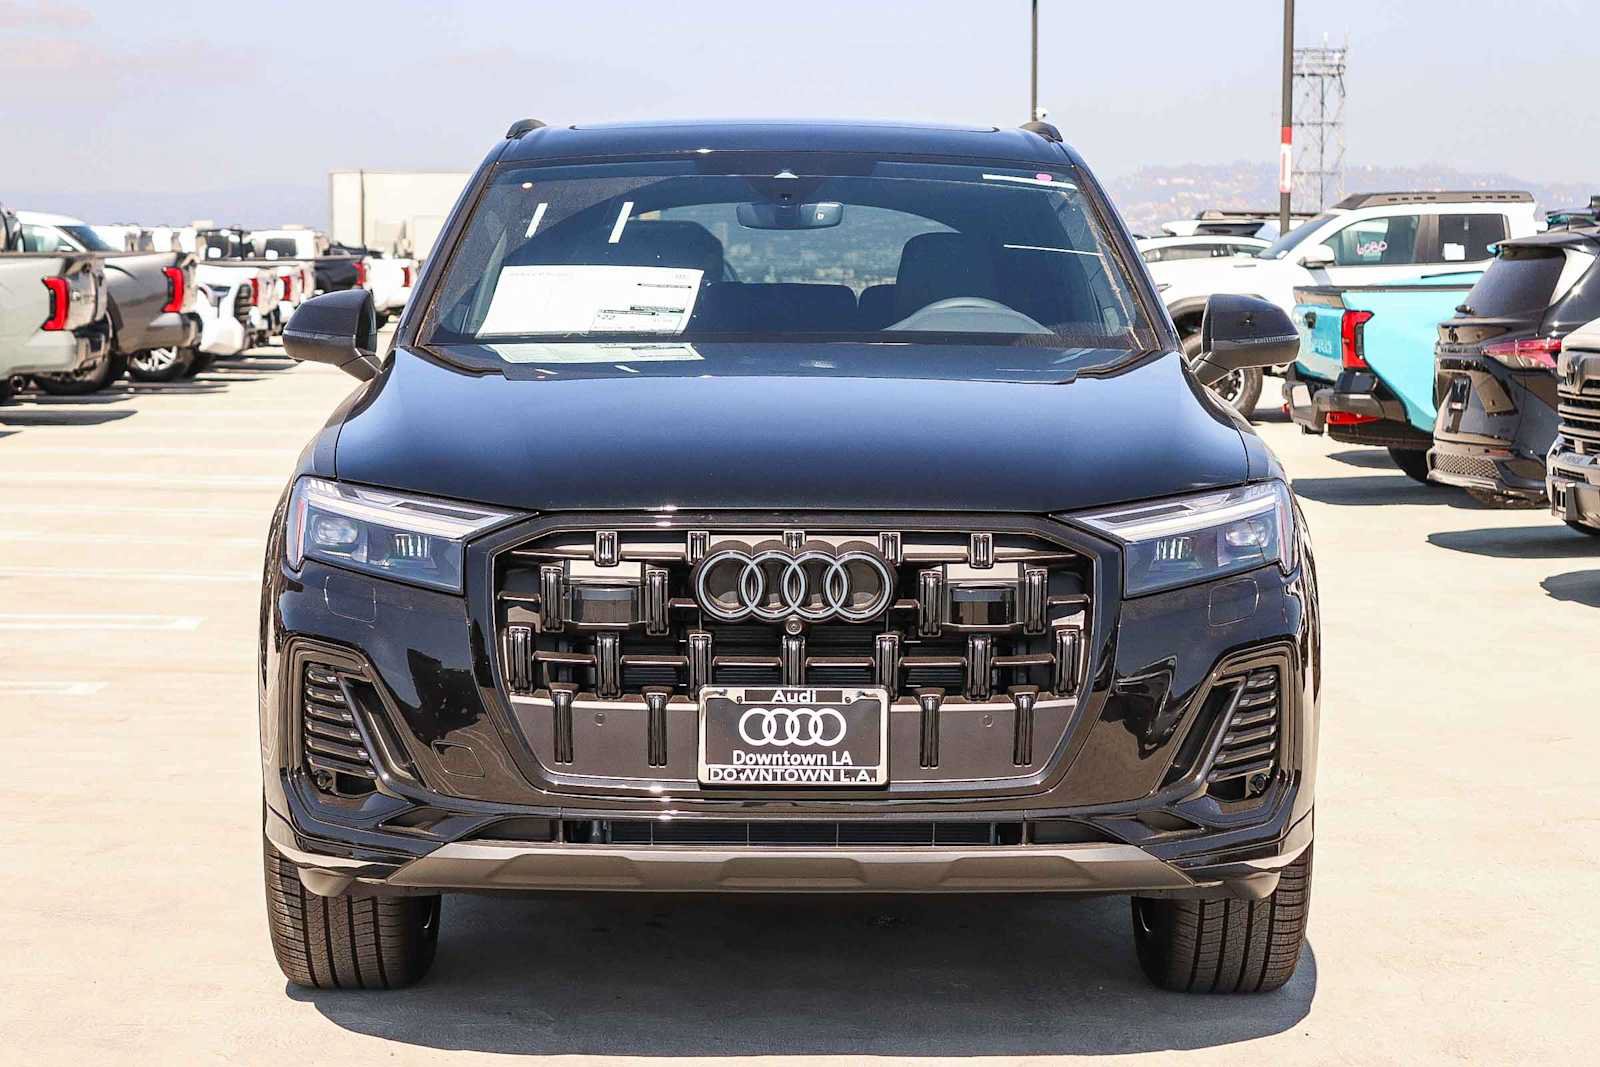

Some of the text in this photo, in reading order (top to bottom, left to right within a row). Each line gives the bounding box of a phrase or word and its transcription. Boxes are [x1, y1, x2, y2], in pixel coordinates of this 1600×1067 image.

[771, 690, 816, 704] Audi
[732, 750, 853, 766] Downtown LA
[710, 768, 876, 782] DOWNTOWN L.A.
